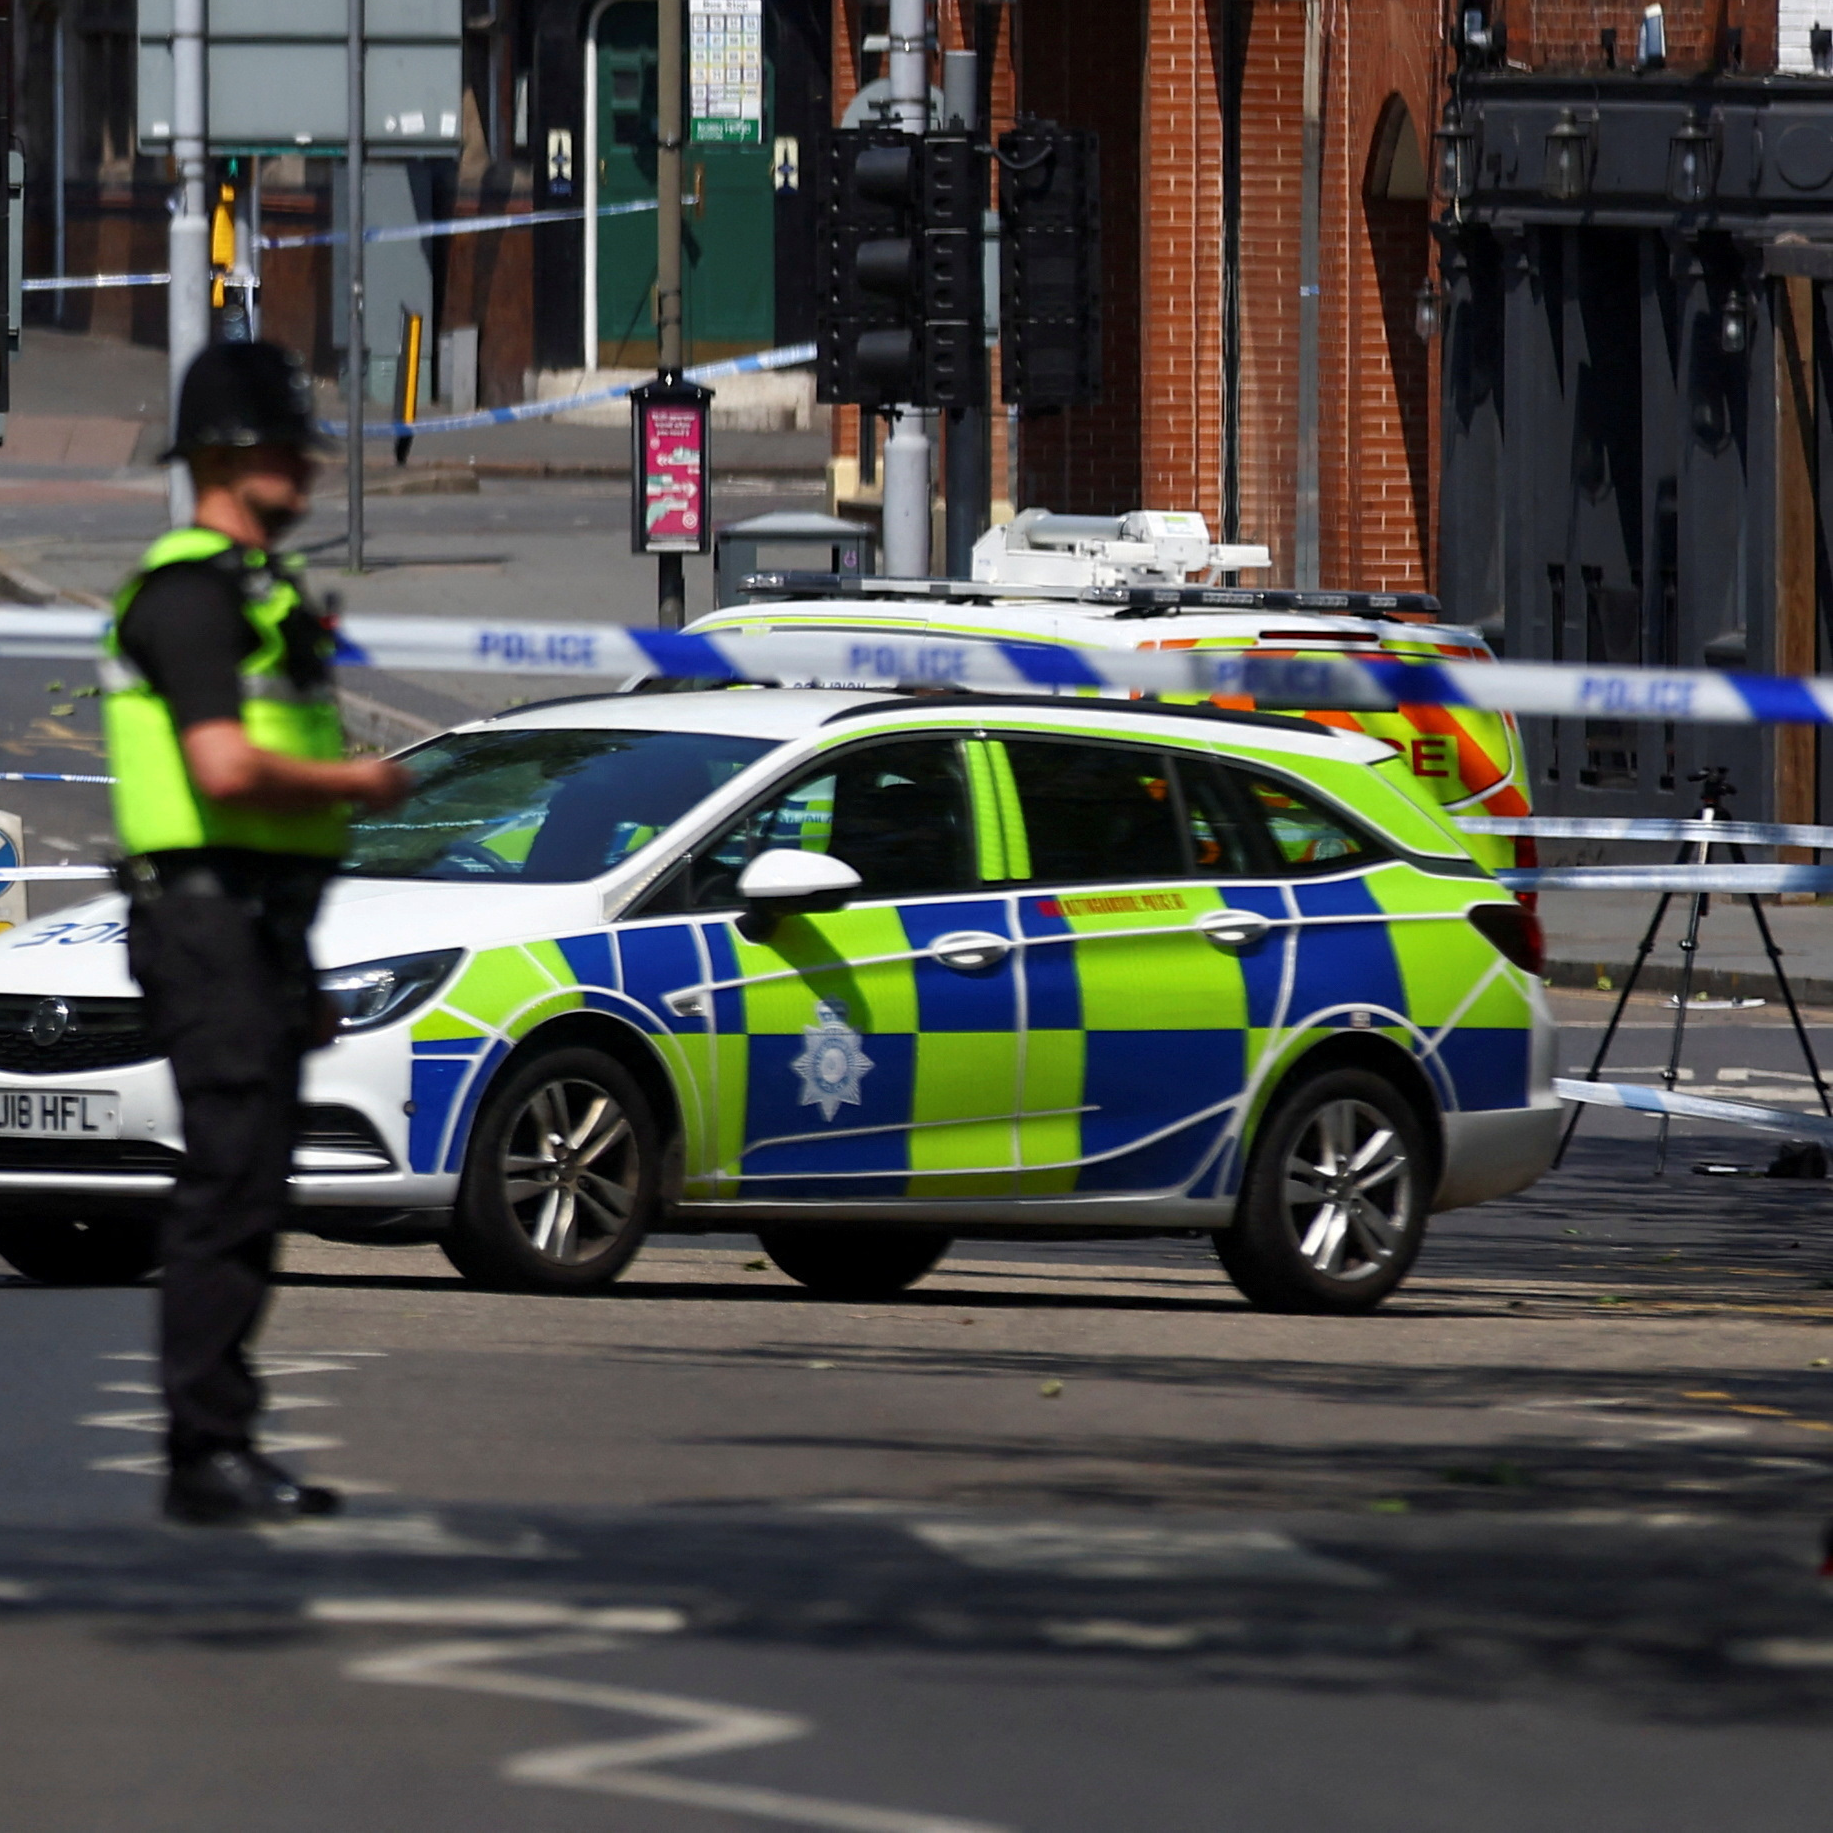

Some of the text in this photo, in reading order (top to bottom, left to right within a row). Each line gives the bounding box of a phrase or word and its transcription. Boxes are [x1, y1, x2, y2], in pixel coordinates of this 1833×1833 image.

[479, 630, 598, 666] POLICE
[850, 643, 973, 680] POLICE
[1580, 676, 1701, 715] POLICE
[41, 1096, 99, 1132] HFL
